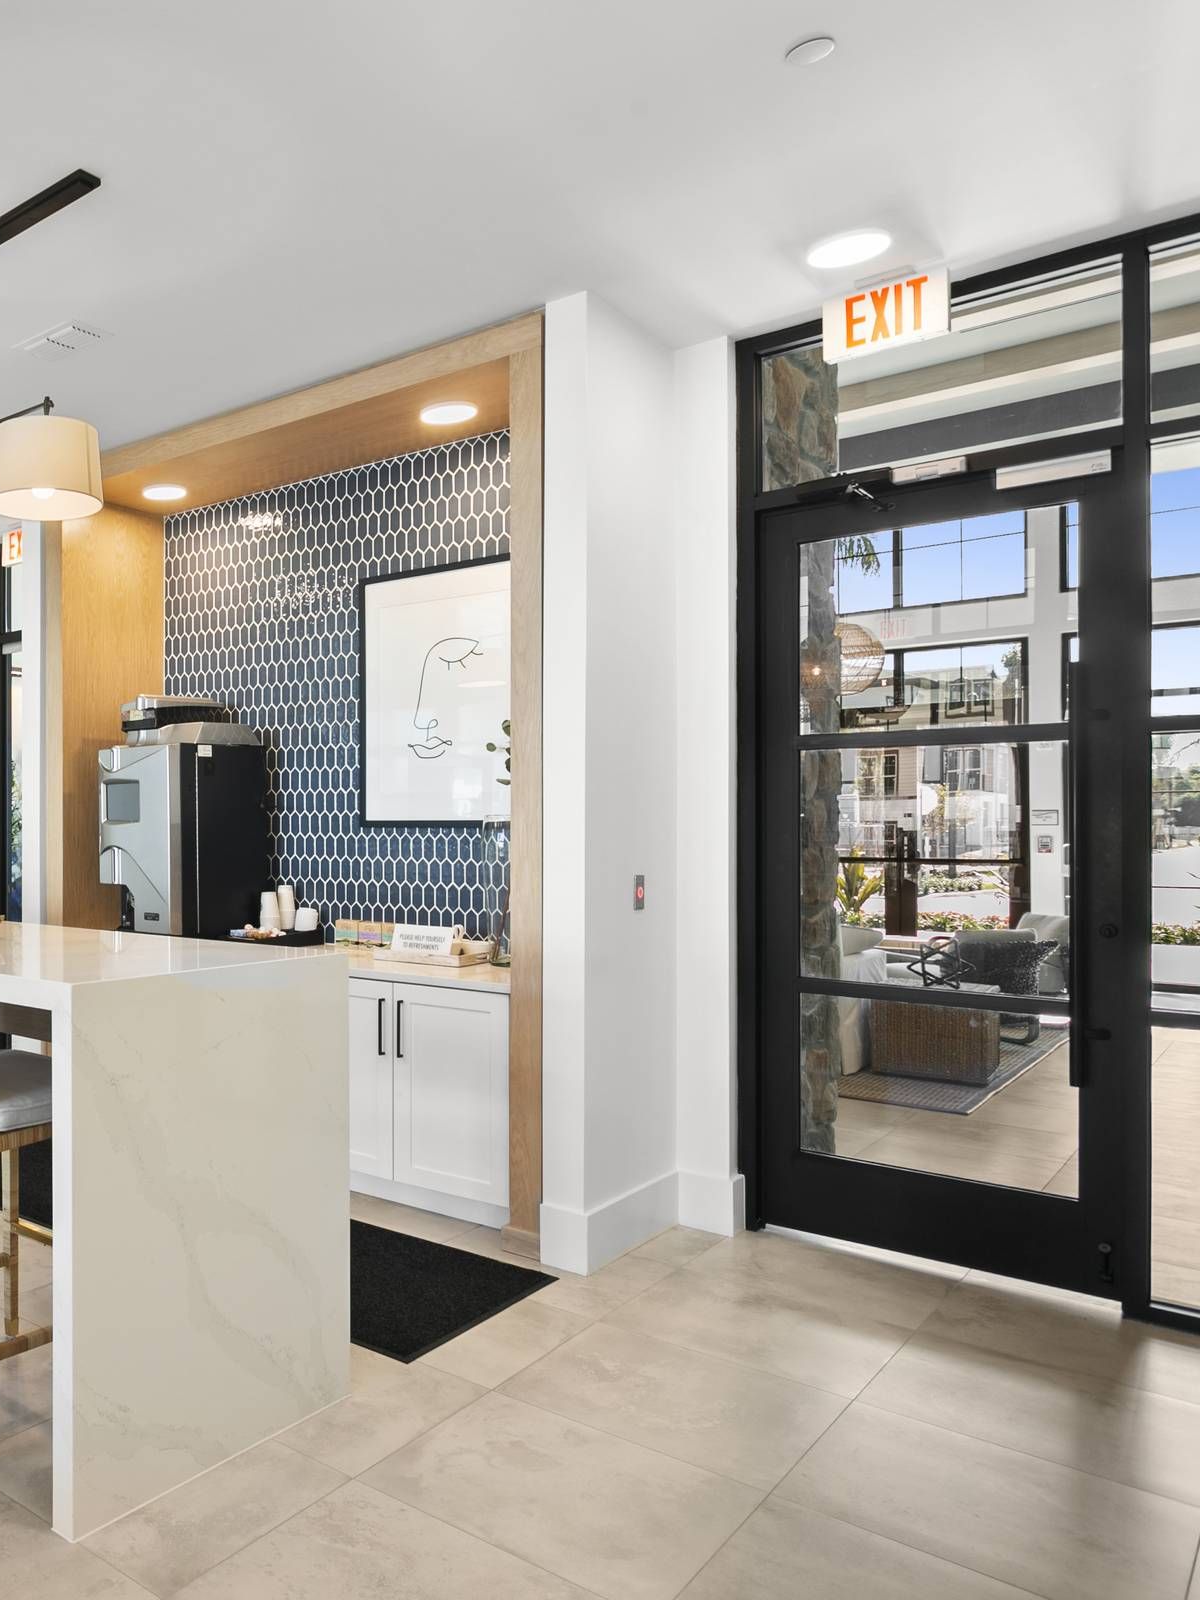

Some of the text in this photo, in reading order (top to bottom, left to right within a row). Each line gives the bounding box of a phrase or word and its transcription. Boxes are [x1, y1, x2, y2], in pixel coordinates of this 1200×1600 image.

[845, 275, 928, 349] EXIT
[9, 529, 22, 560] EX
[415, 934, 425, 942] HELP
